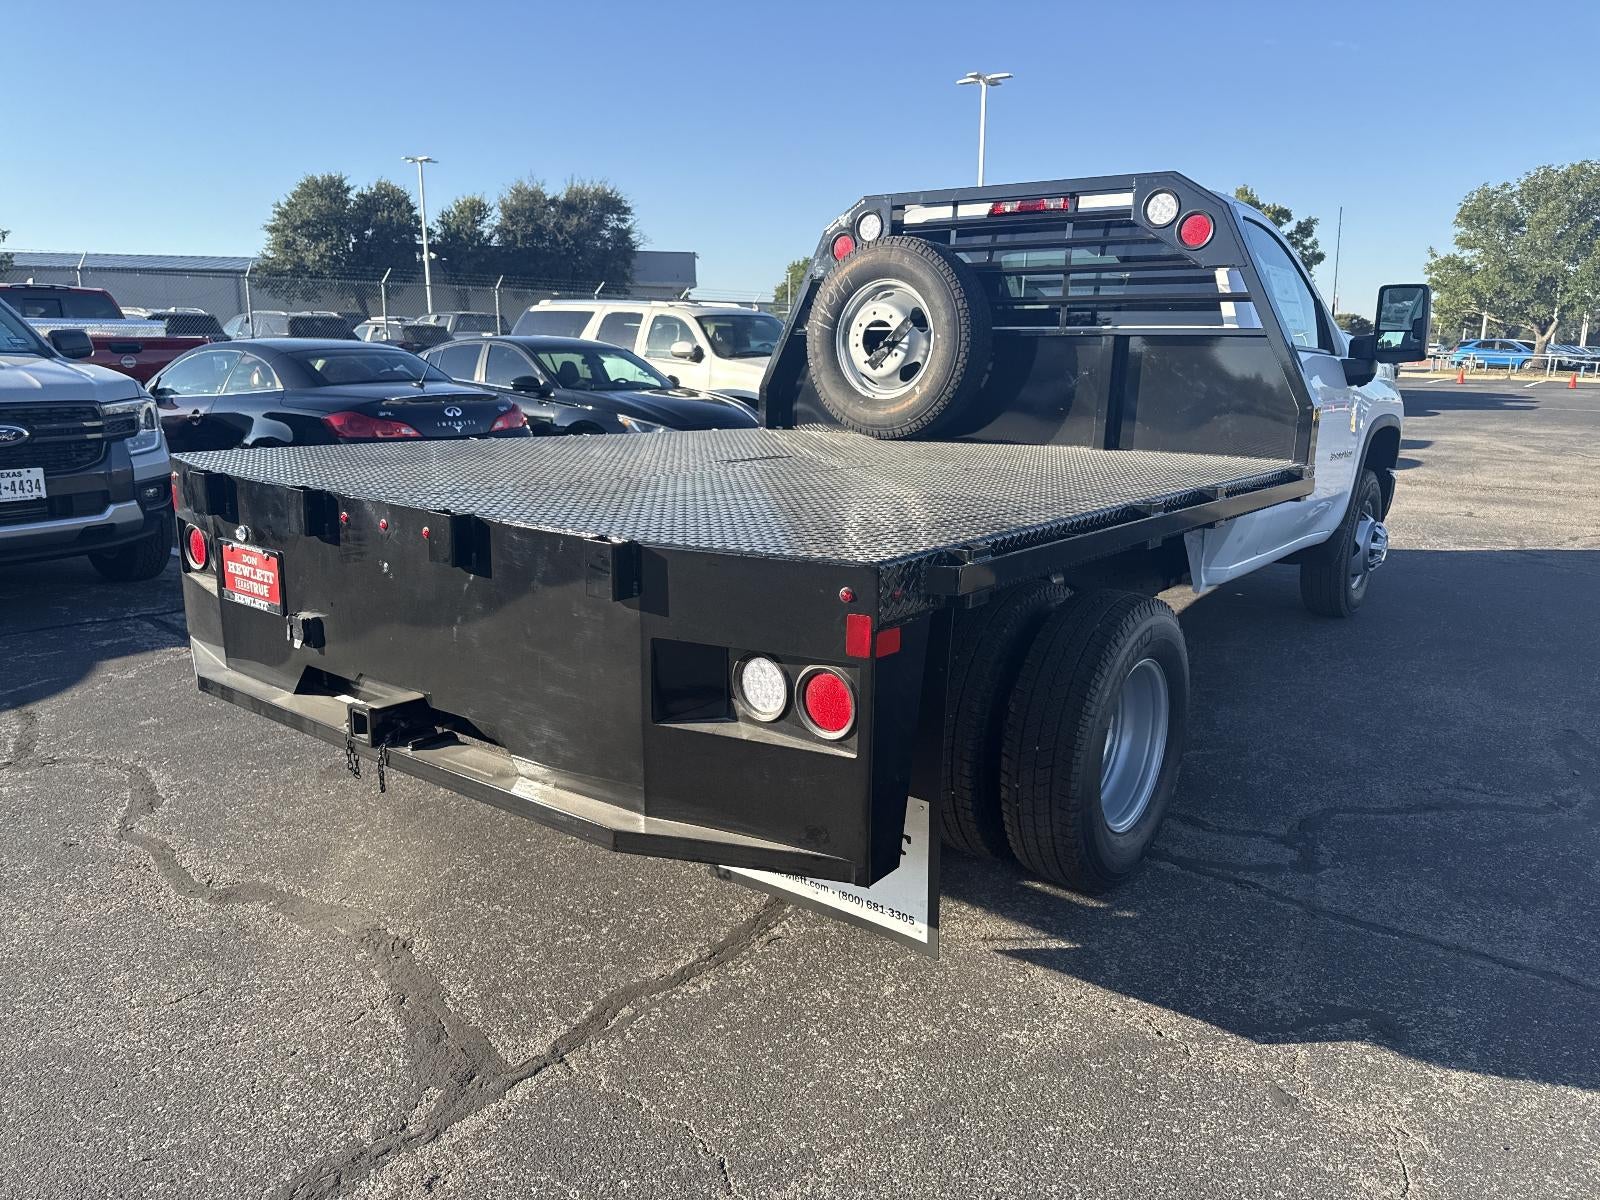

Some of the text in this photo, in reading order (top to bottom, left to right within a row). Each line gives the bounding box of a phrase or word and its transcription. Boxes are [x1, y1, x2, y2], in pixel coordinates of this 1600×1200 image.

[0, 471, 22, 479] EXAS
[242, 554, 258, 566] DON
[227, 561, 275, 584] HEWLETT
[234, 593, 270, 612] HEWLETT
[838, 890, 864, 908] (800)
[866, 900, 915, 926] 681-3305
